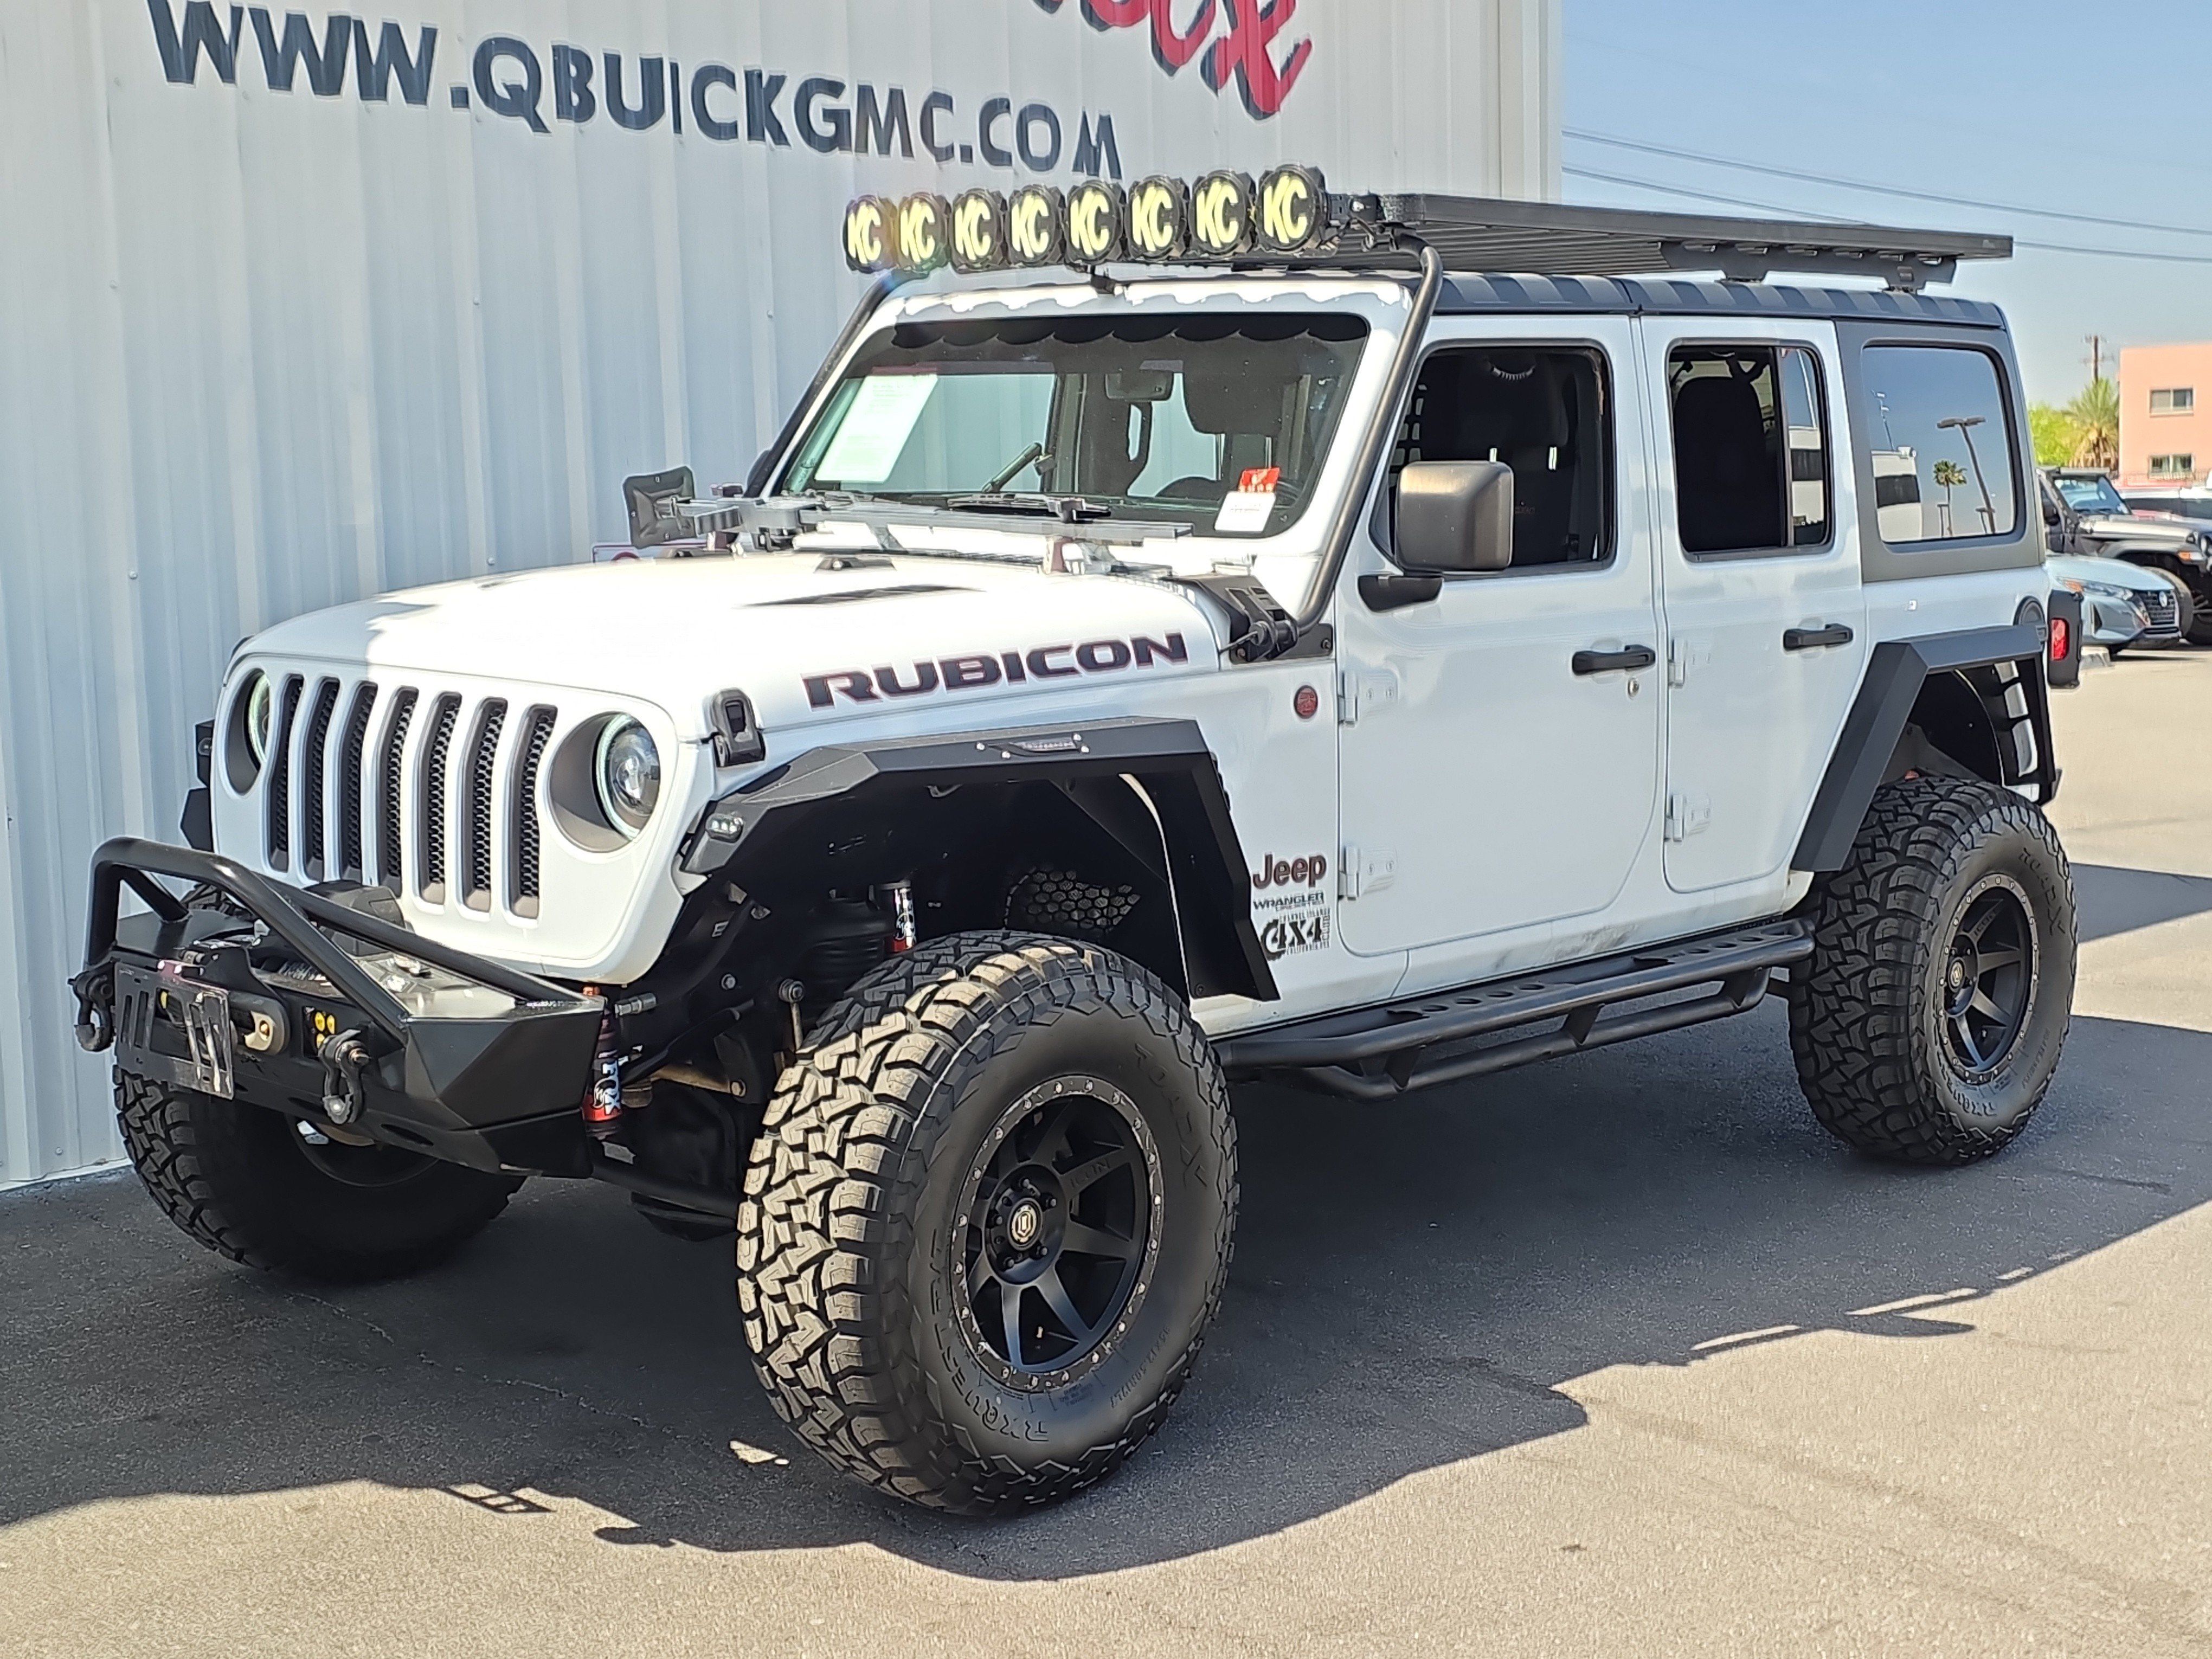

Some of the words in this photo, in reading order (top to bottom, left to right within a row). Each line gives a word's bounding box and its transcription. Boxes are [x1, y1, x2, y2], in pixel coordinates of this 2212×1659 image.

[848, 203, 881, 262] KC
[901, 202, 936, 264] KC
[954, 199, 991, 261] KC
[1012, 193, 1050, 259] KC
[1070, 192, 1109, 255] KC
[1132, 185, 1173, 252] KC
[1195, 179, 1239, 248] KC
[1263, 173, 1307, 243] KC
[800, 631, 1188, 709] RUBICON
[1253, 854, 1327, 890] Jeep
[1253, 891, 1324, 910] WRANGLER
